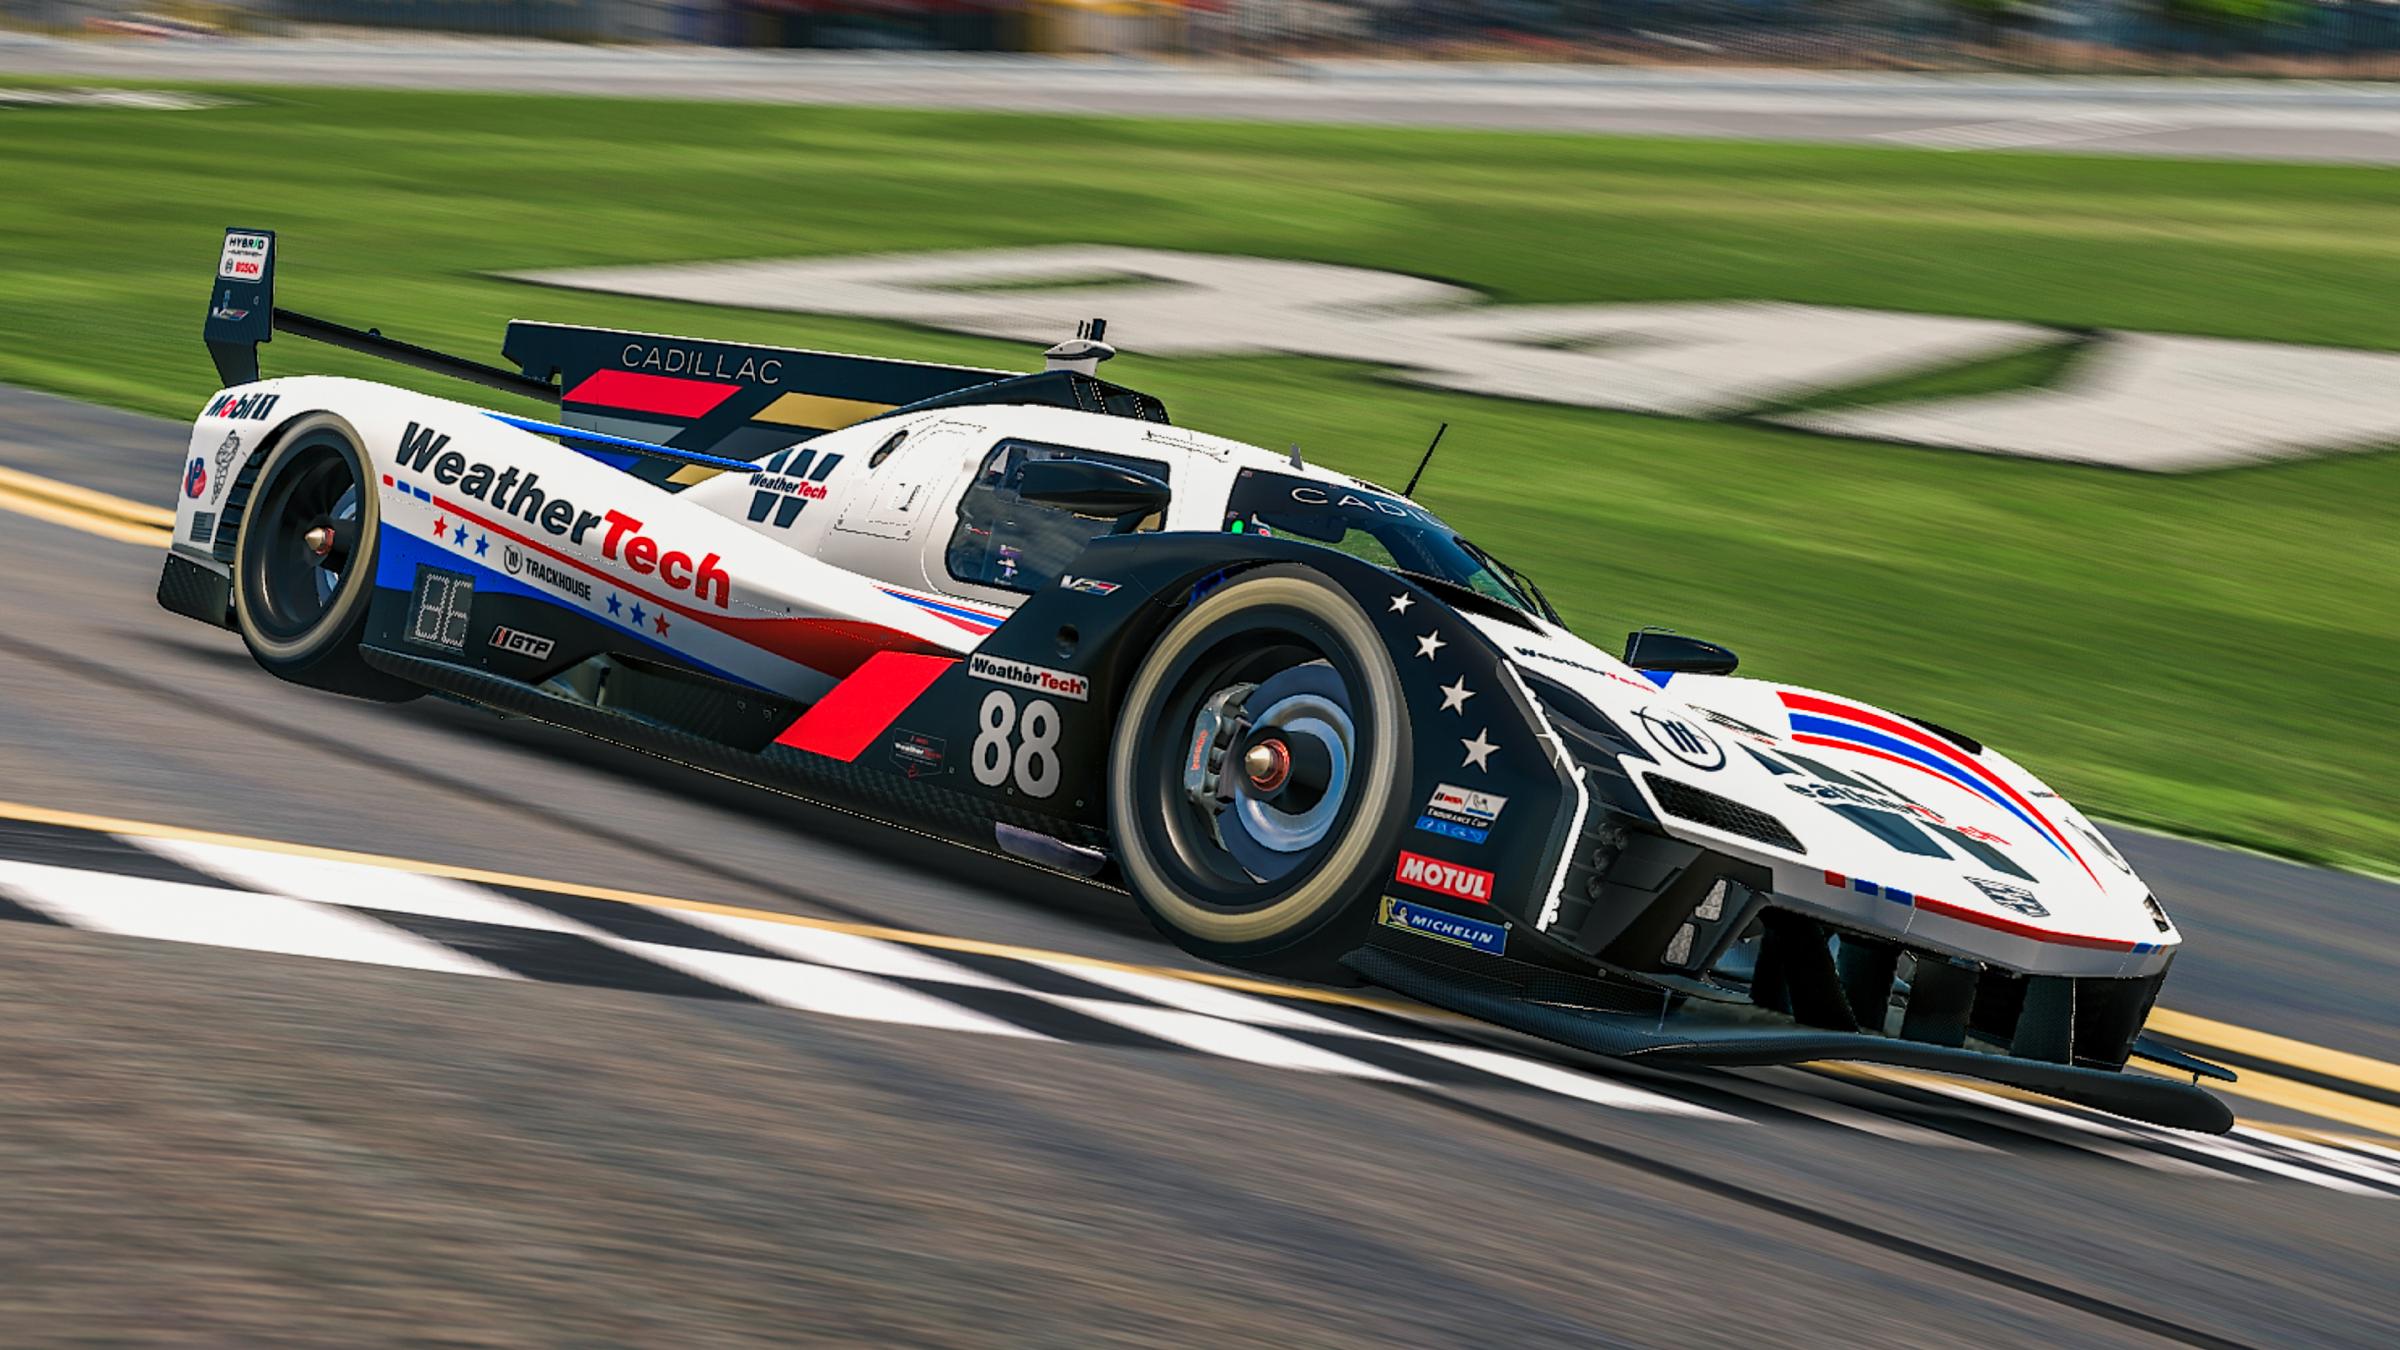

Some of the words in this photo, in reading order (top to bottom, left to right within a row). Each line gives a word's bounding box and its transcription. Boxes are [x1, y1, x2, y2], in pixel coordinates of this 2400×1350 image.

[622, 344, 782, 384] CADILLAC
[206, 393, 260, 420] Mobil
[749, 473, 827, 500] WeatherTech
[395, 421, 730, 609] WeatherTech
[525, 557, 592, 601] TRACKHOUSE
[508, 634, 550, 655] GTP
[973, 656, 1083, 695] WeatherTech
[971, 689, 1061, 799] 88
[1401, 857, 1486, 897] MOTUL
[1411, 914, 1494, 943] MICHELIN
